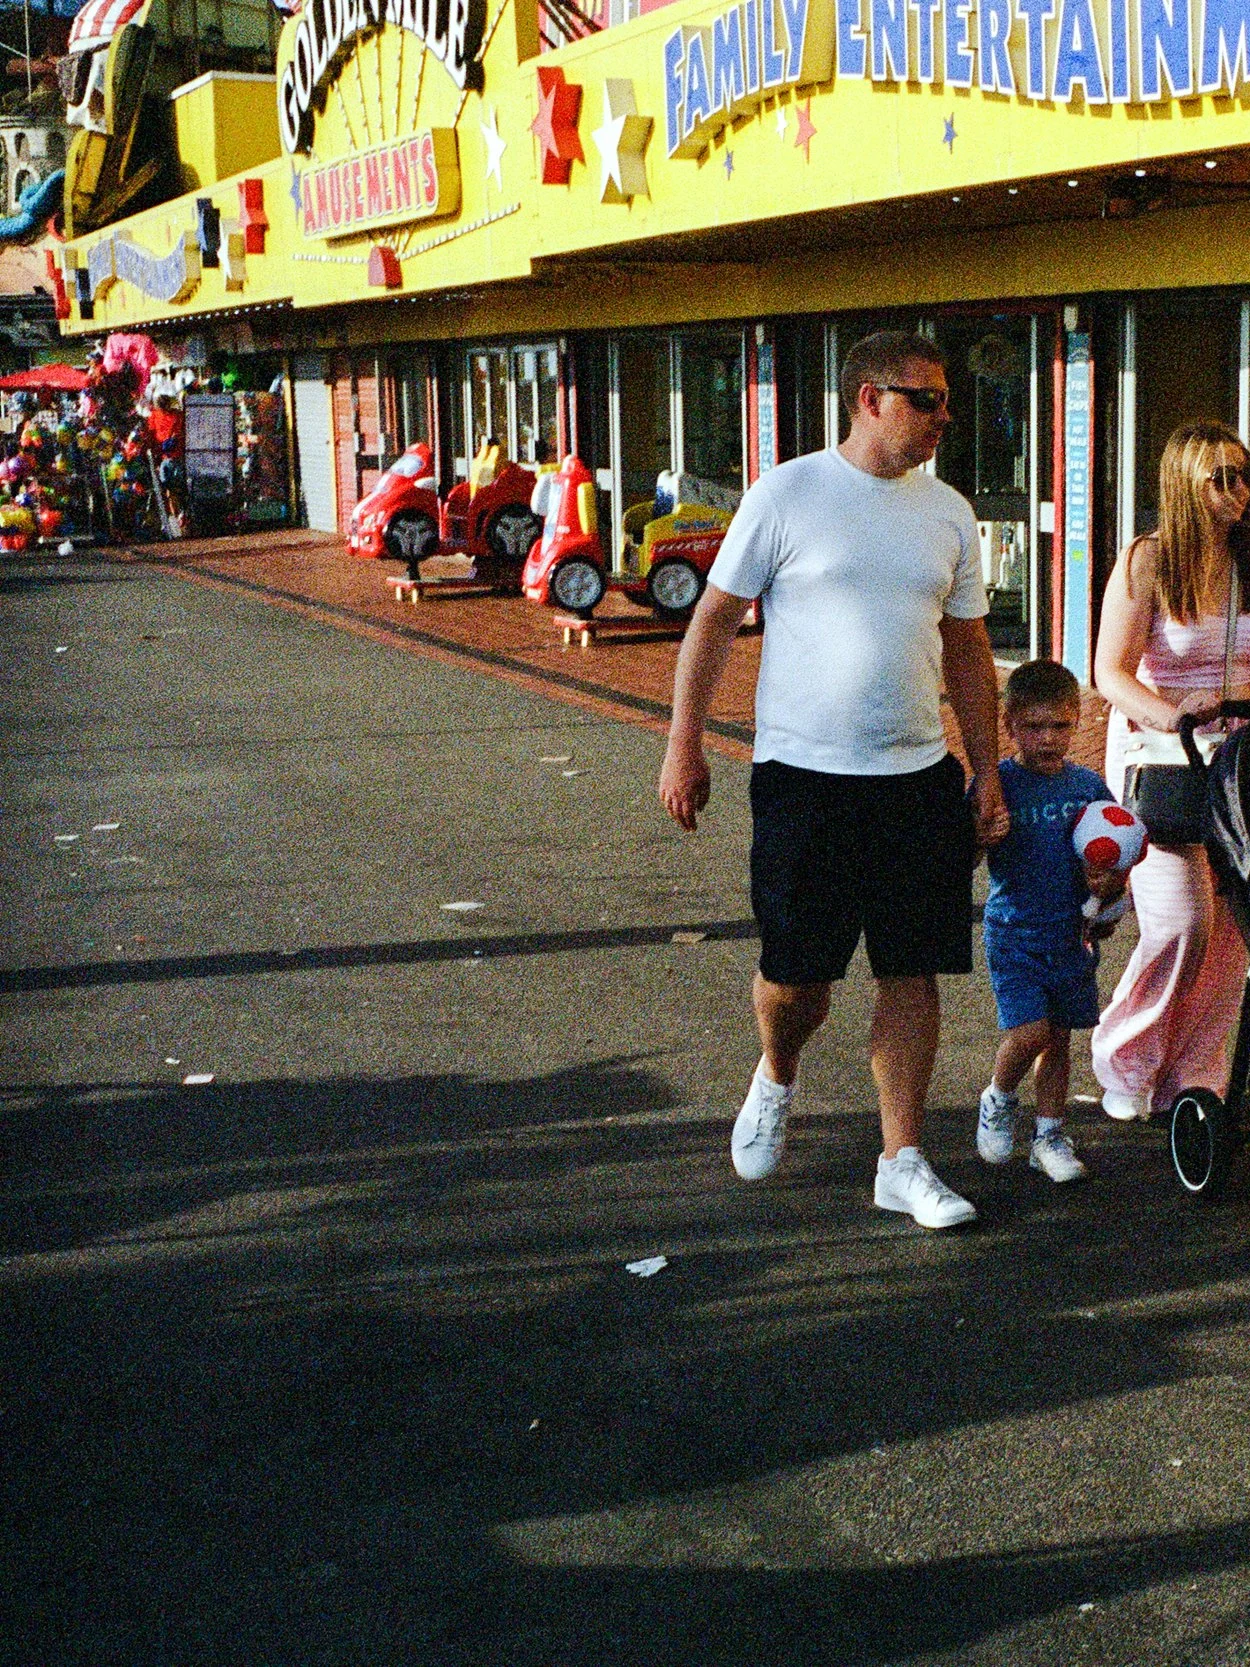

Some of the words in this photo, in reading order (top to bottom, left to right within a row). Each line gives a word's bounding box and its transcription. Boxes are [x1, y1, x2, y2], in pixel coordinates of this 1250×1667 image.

[280, 0, 382, 154] GOLD
[386, 0, 468, 91] LE
[664, 0, 808, 159] FAMILY
[303, 134, 437, 236] AMUSEMENTS
[1012, 800, 1087, 824] ICC
